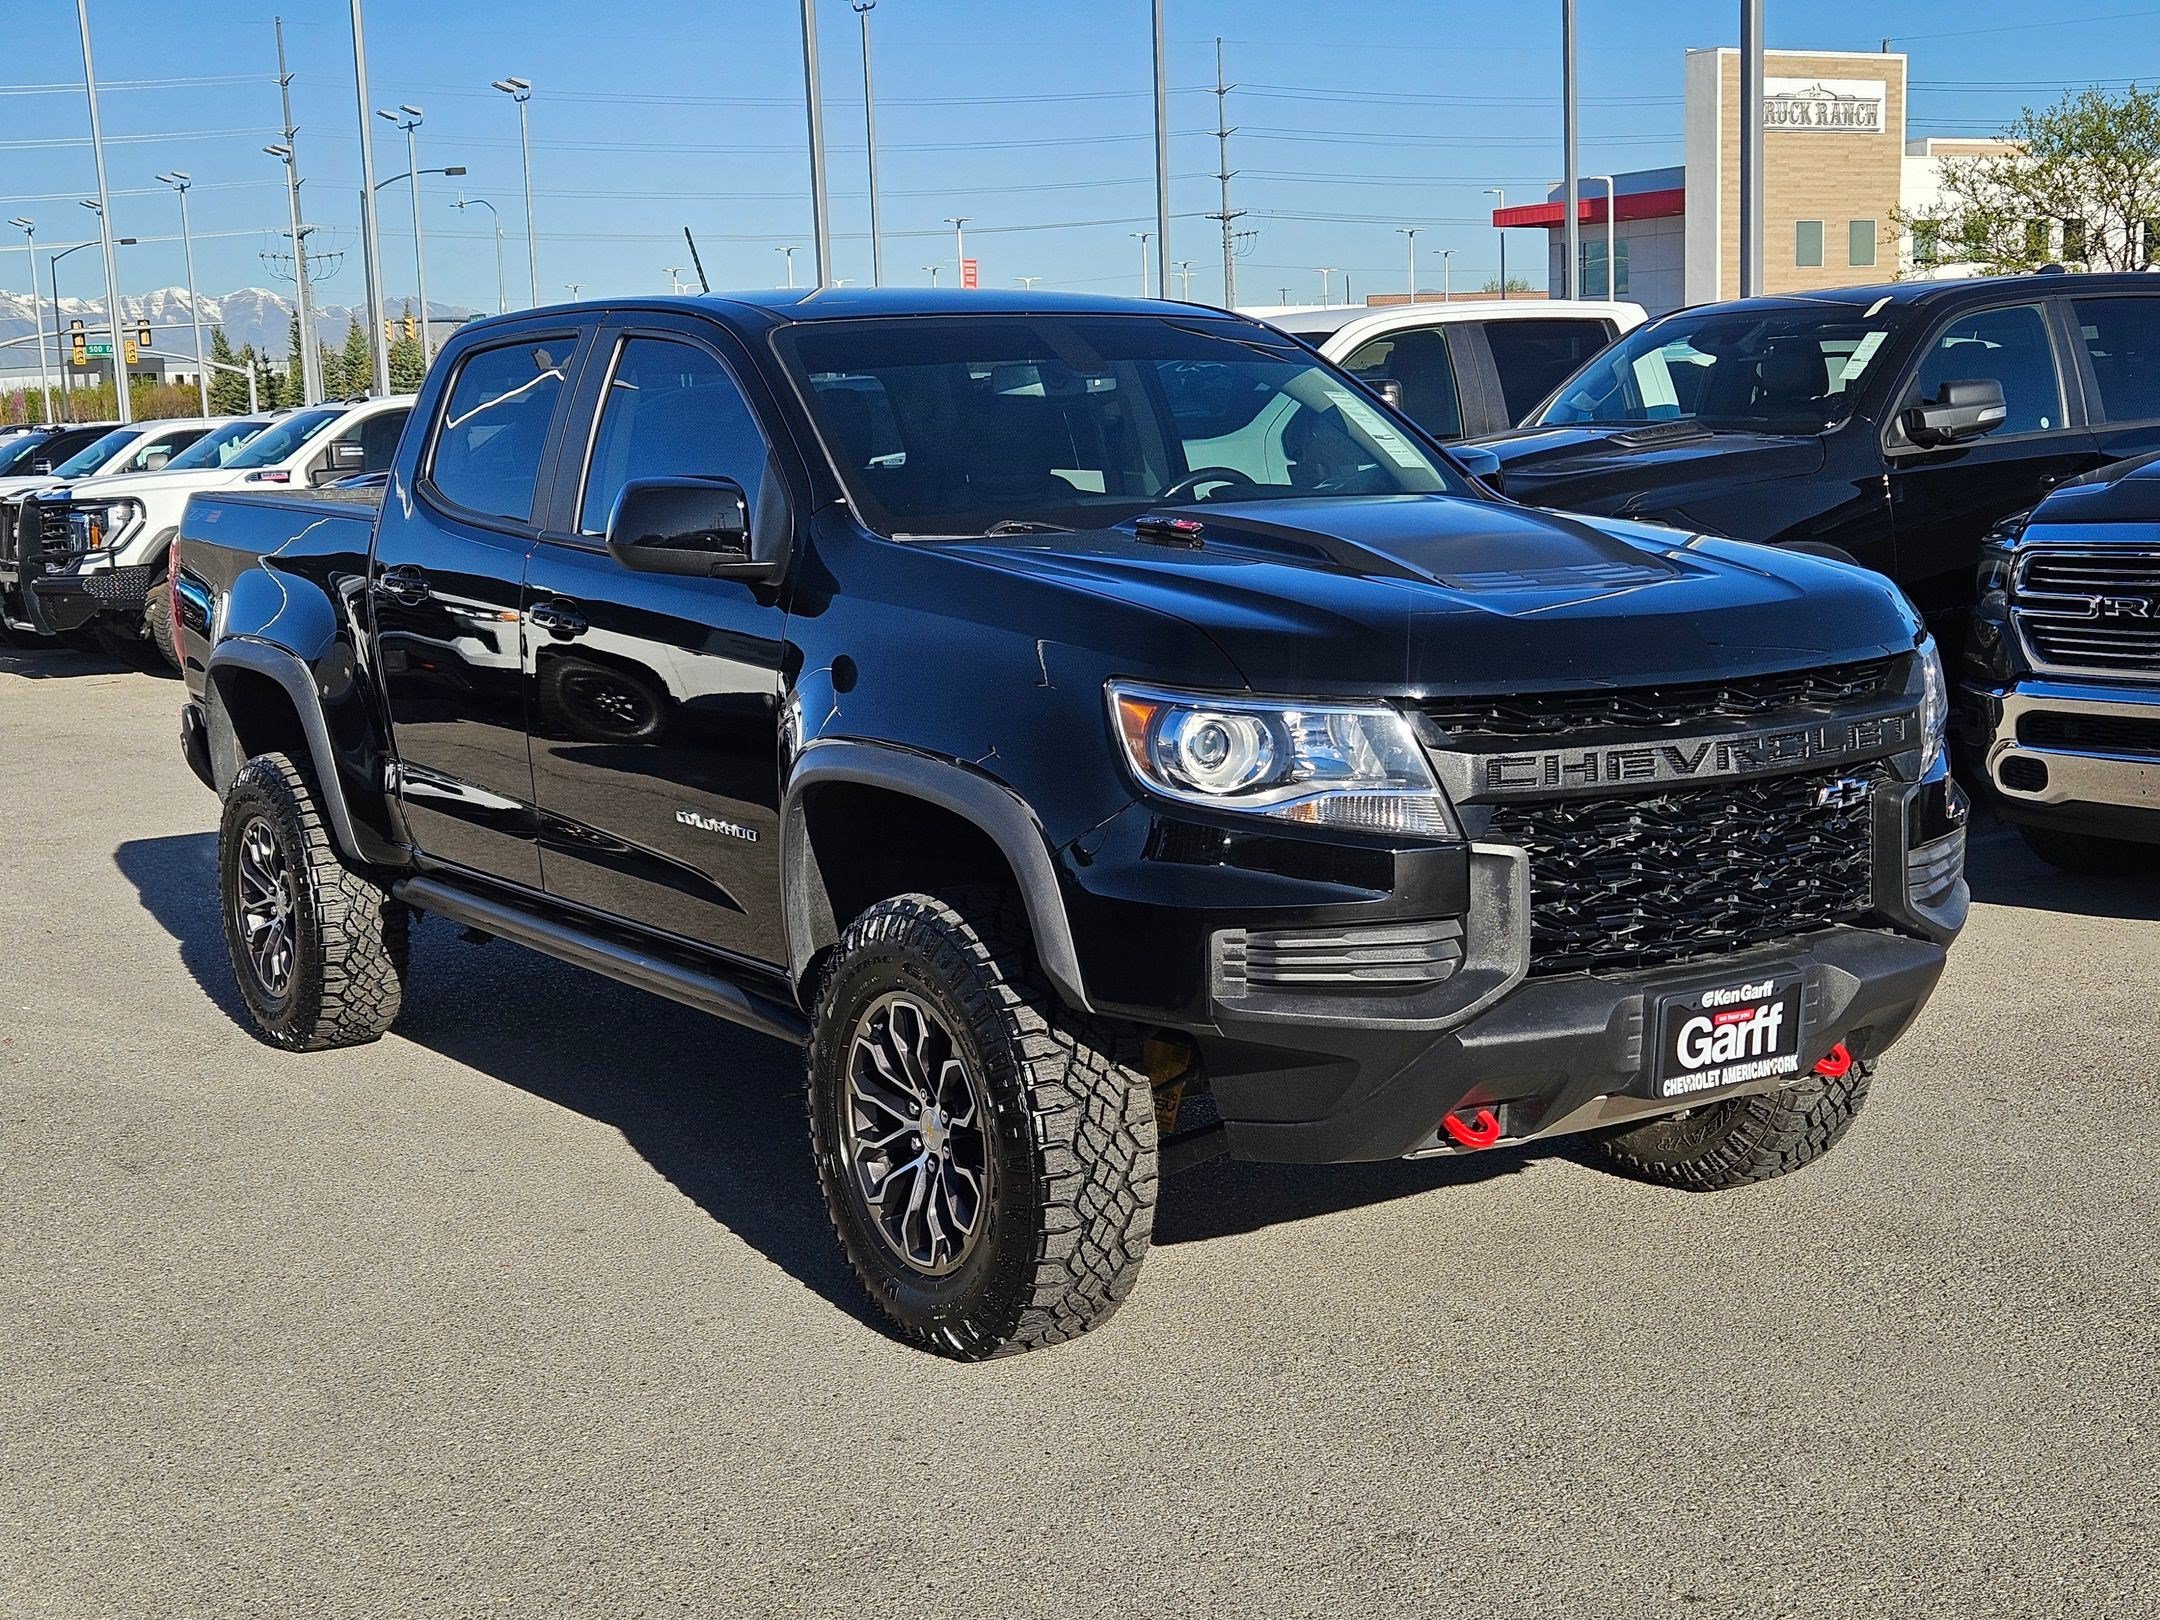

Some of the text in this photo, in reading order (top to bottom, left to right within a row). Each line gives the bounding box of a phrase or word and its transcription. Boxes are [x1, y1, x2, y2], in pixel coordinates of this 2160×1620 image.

[1763, 101, 1878, 126] RUCK RANCH
[88, 345, 103, 353] 500
[1486, 711, 1916, 789] CHEVROLET
[675, 810, 758, 842] COLORADO
[1713, 979, 1774, 1007] Ken Garff
[1677, 1002, 1783, 1069] Garff
[1662, 1053, 1799, 1097] CHEVROLET AMERICAN FORK
